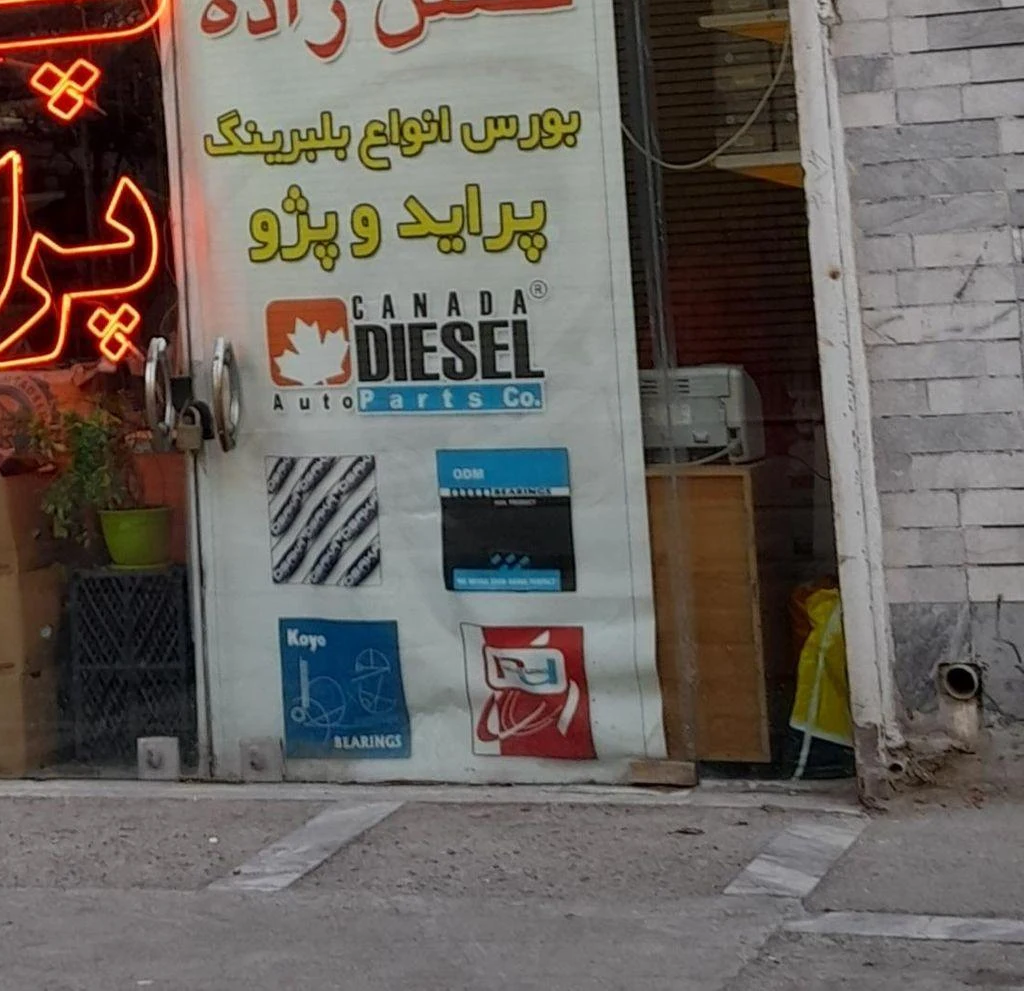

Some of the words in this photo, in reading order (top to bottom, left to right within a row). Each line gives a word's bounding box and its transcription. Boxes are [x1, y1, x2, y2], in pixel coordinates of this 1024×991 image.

[203, 110, 352, 164] بلبرینگ
[357, 105, 453, 170] انواع
[461, 107, 581, 151] بورس
[248, 184, 340, 272] پژو
[350, 204, 381, 258] و
[396, 184, 548, 263] پراید
[352, 288, 527, 320] CANADA
[354, 319, 545, 382] DIESEL
[273, 393, 353, 411] Auto
[359, 388, 483, 409] Parts
[494, 487, 552, 497] BEARINGS
[333, 733, 403, 750] BEARINGS
